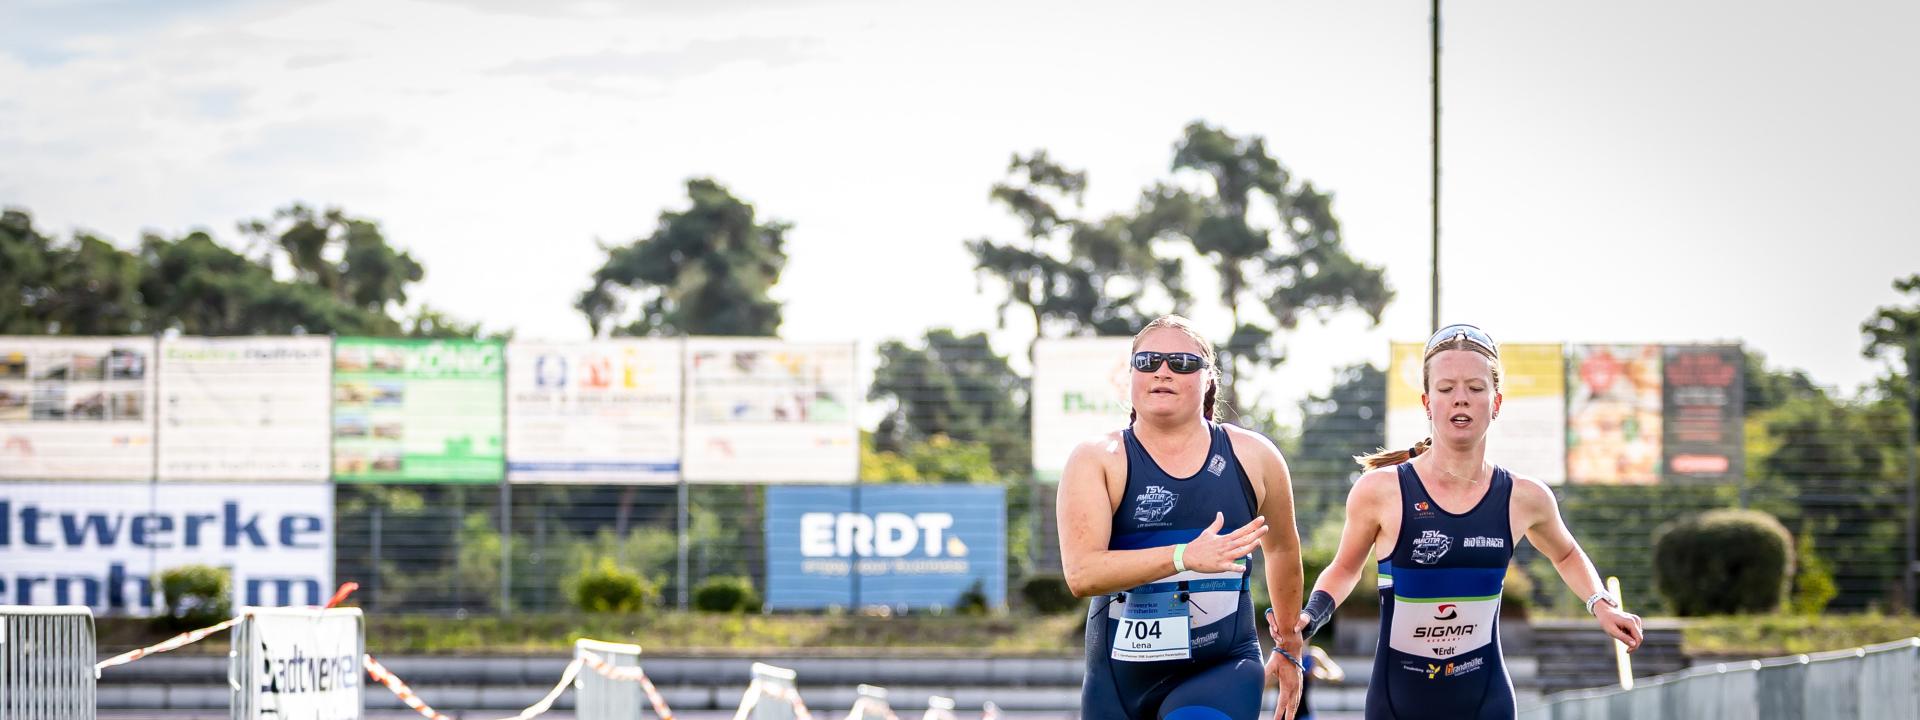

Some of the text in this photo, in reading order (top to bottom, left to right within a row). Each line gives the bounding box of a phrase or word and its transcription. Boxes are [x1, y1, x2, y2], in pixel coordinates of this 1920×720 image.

[1146, 485, 1164, 494] TSV
[1422, 530, 1440, 538] TSV
[1201, 579, 1226, 591] sailfish
[1124, 620, 1162, 640] 704
[1413, 625, 1474, 638] SIGMA
[1191, 631, 1219, 646] ndmüller
[1131, 641, 1152, 649] Lena
[1438, 646, 1455, 656] Erdt
